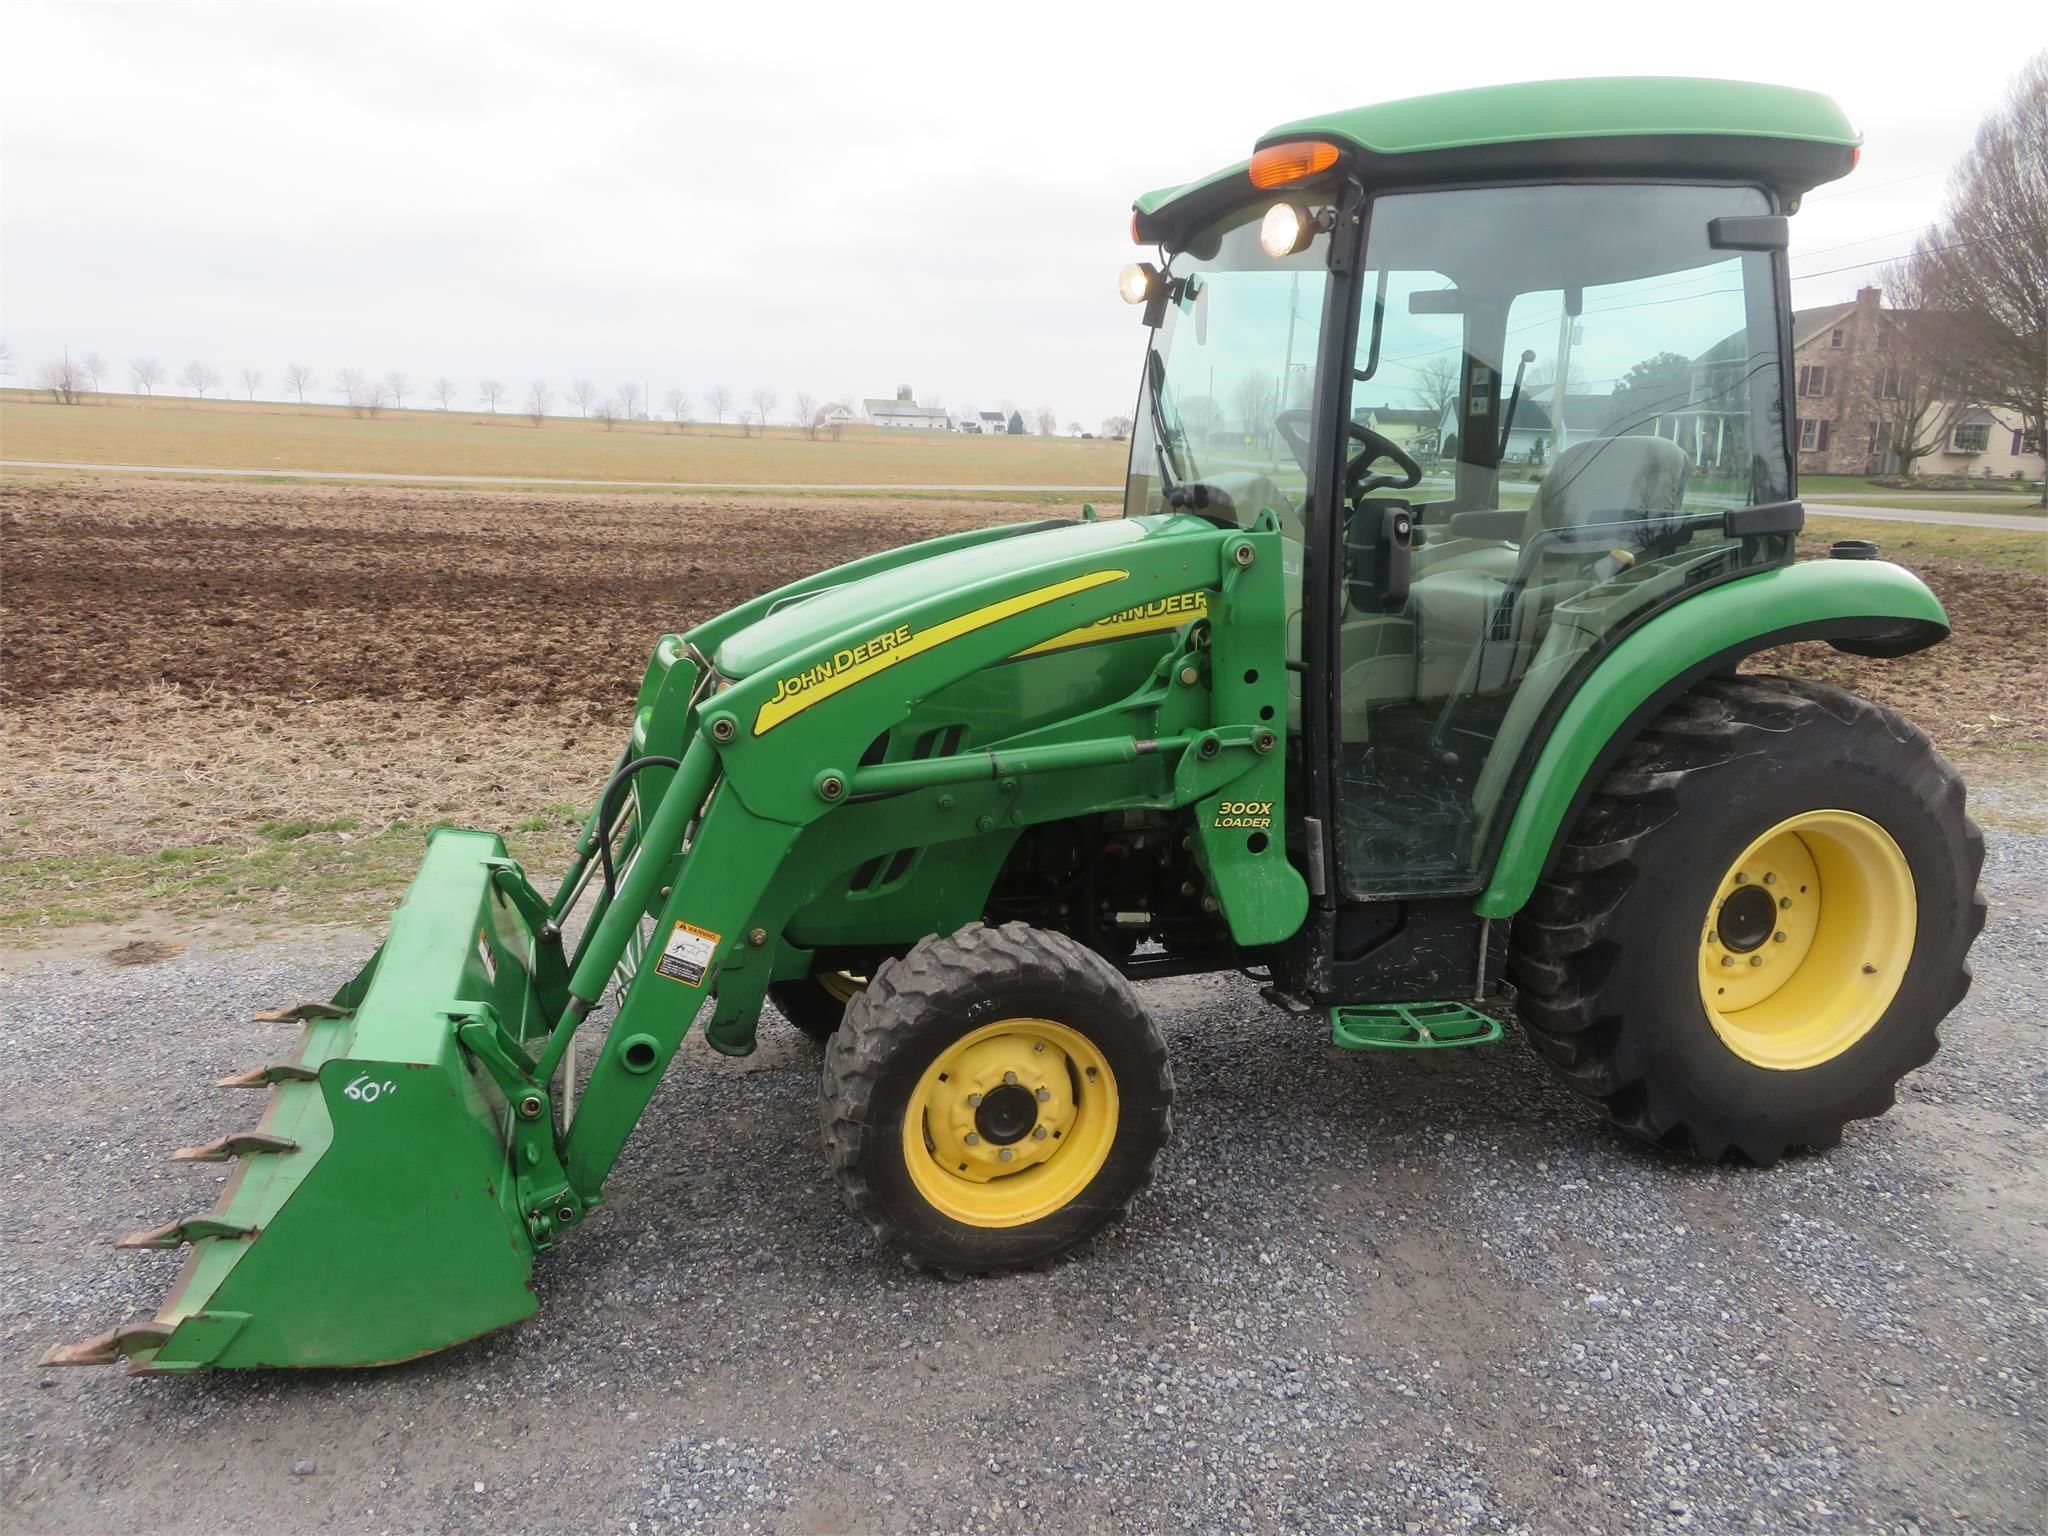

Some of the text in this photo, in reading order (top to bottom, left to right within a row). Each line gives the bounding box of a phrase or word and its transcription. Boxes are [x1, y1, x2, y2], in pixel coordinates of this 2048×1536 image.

[1147, 591, 1207, 617] DEER
[772, 624, 912, 704] JOHN DEERE
[1214, 801, 1273, 828] 300X LOADER
